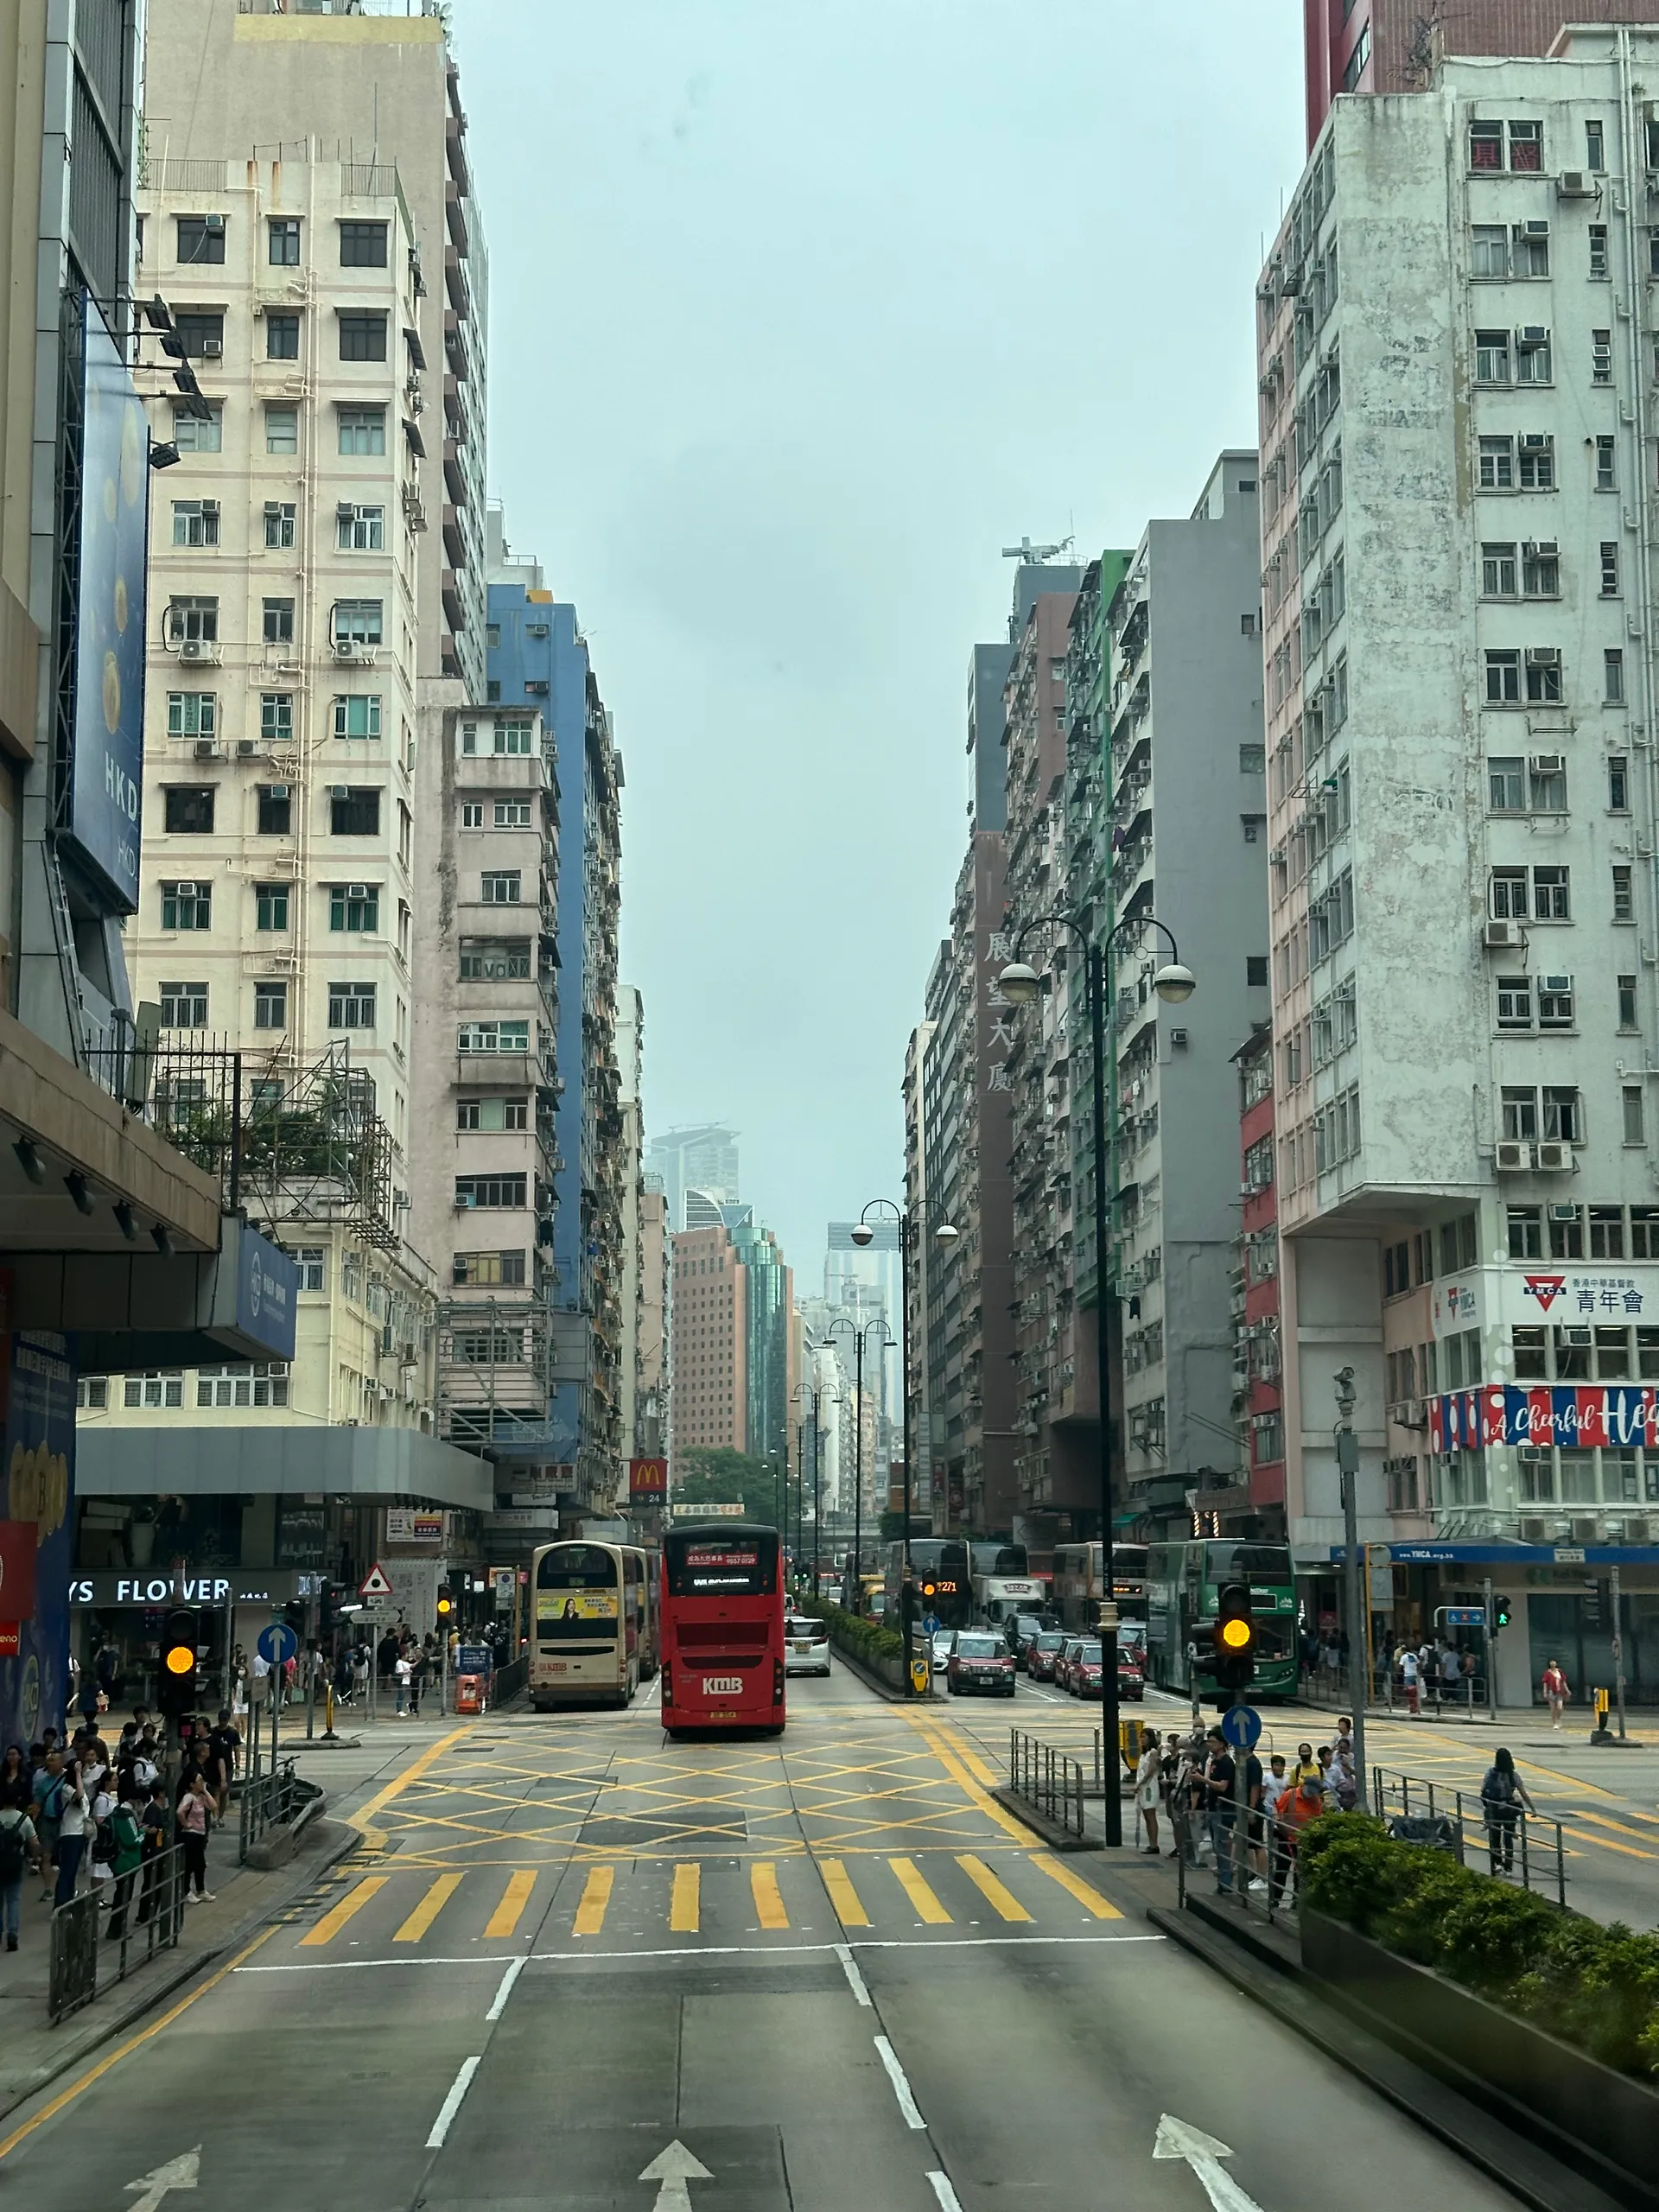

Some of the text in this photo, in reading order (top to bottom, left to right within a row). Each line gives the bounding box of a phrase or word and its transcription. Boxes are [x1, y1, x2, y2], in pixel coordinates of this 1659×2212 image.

[105, 750, 137, 822] HKD
[1573, 1278, 1636, 1288] 香港中華基督教
[1576, 1289, 1644, 1313] 青年會
[1515, 1404, 1596, 1433] Cheerful
[118, 1579, 229, 1601] FLOWER
[942, 1581, 957, 1591] 271
[702, 1676, 743, 1694] KMB
